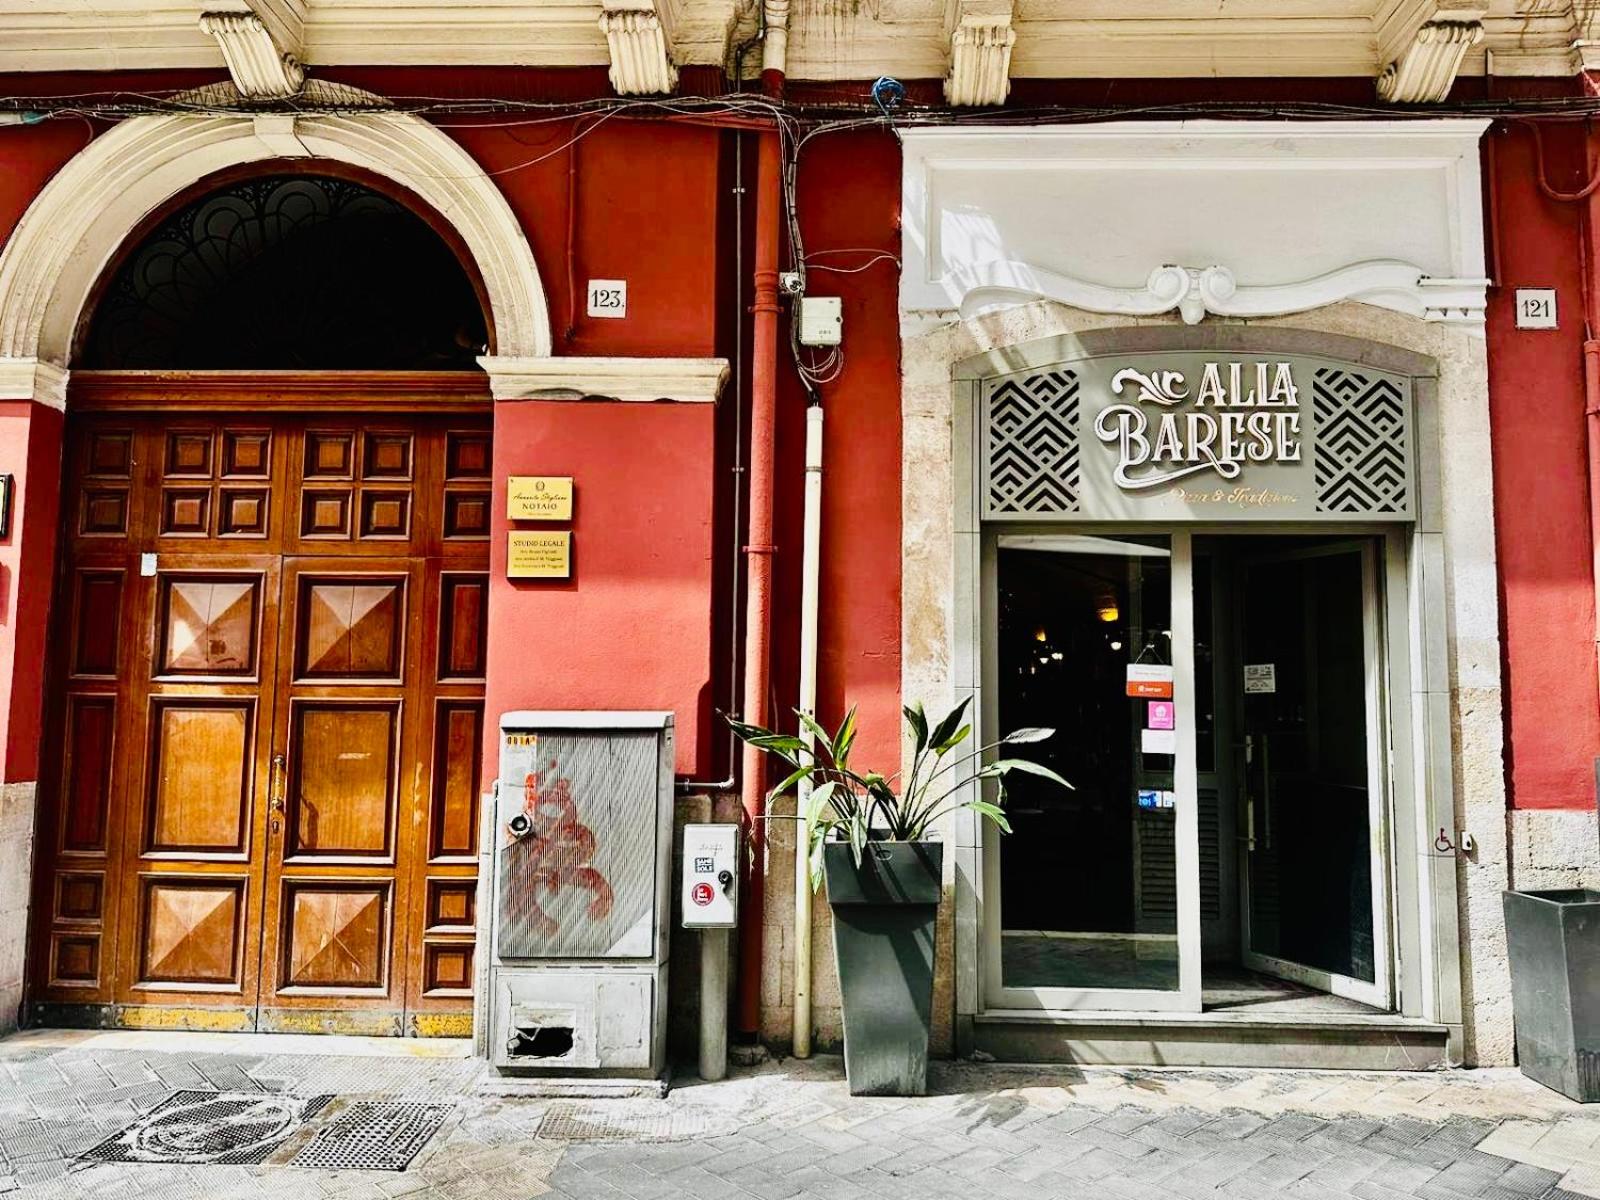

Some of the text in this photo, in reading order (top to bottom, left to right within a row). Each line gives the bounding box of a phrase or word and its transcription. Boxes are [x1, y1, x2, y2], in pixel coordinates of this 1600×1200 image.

[1520, 299, 1550, 318] 121
[1194, 362, 1300, 407] ALLA
[1094, 403, 1301, 489] BARESE
